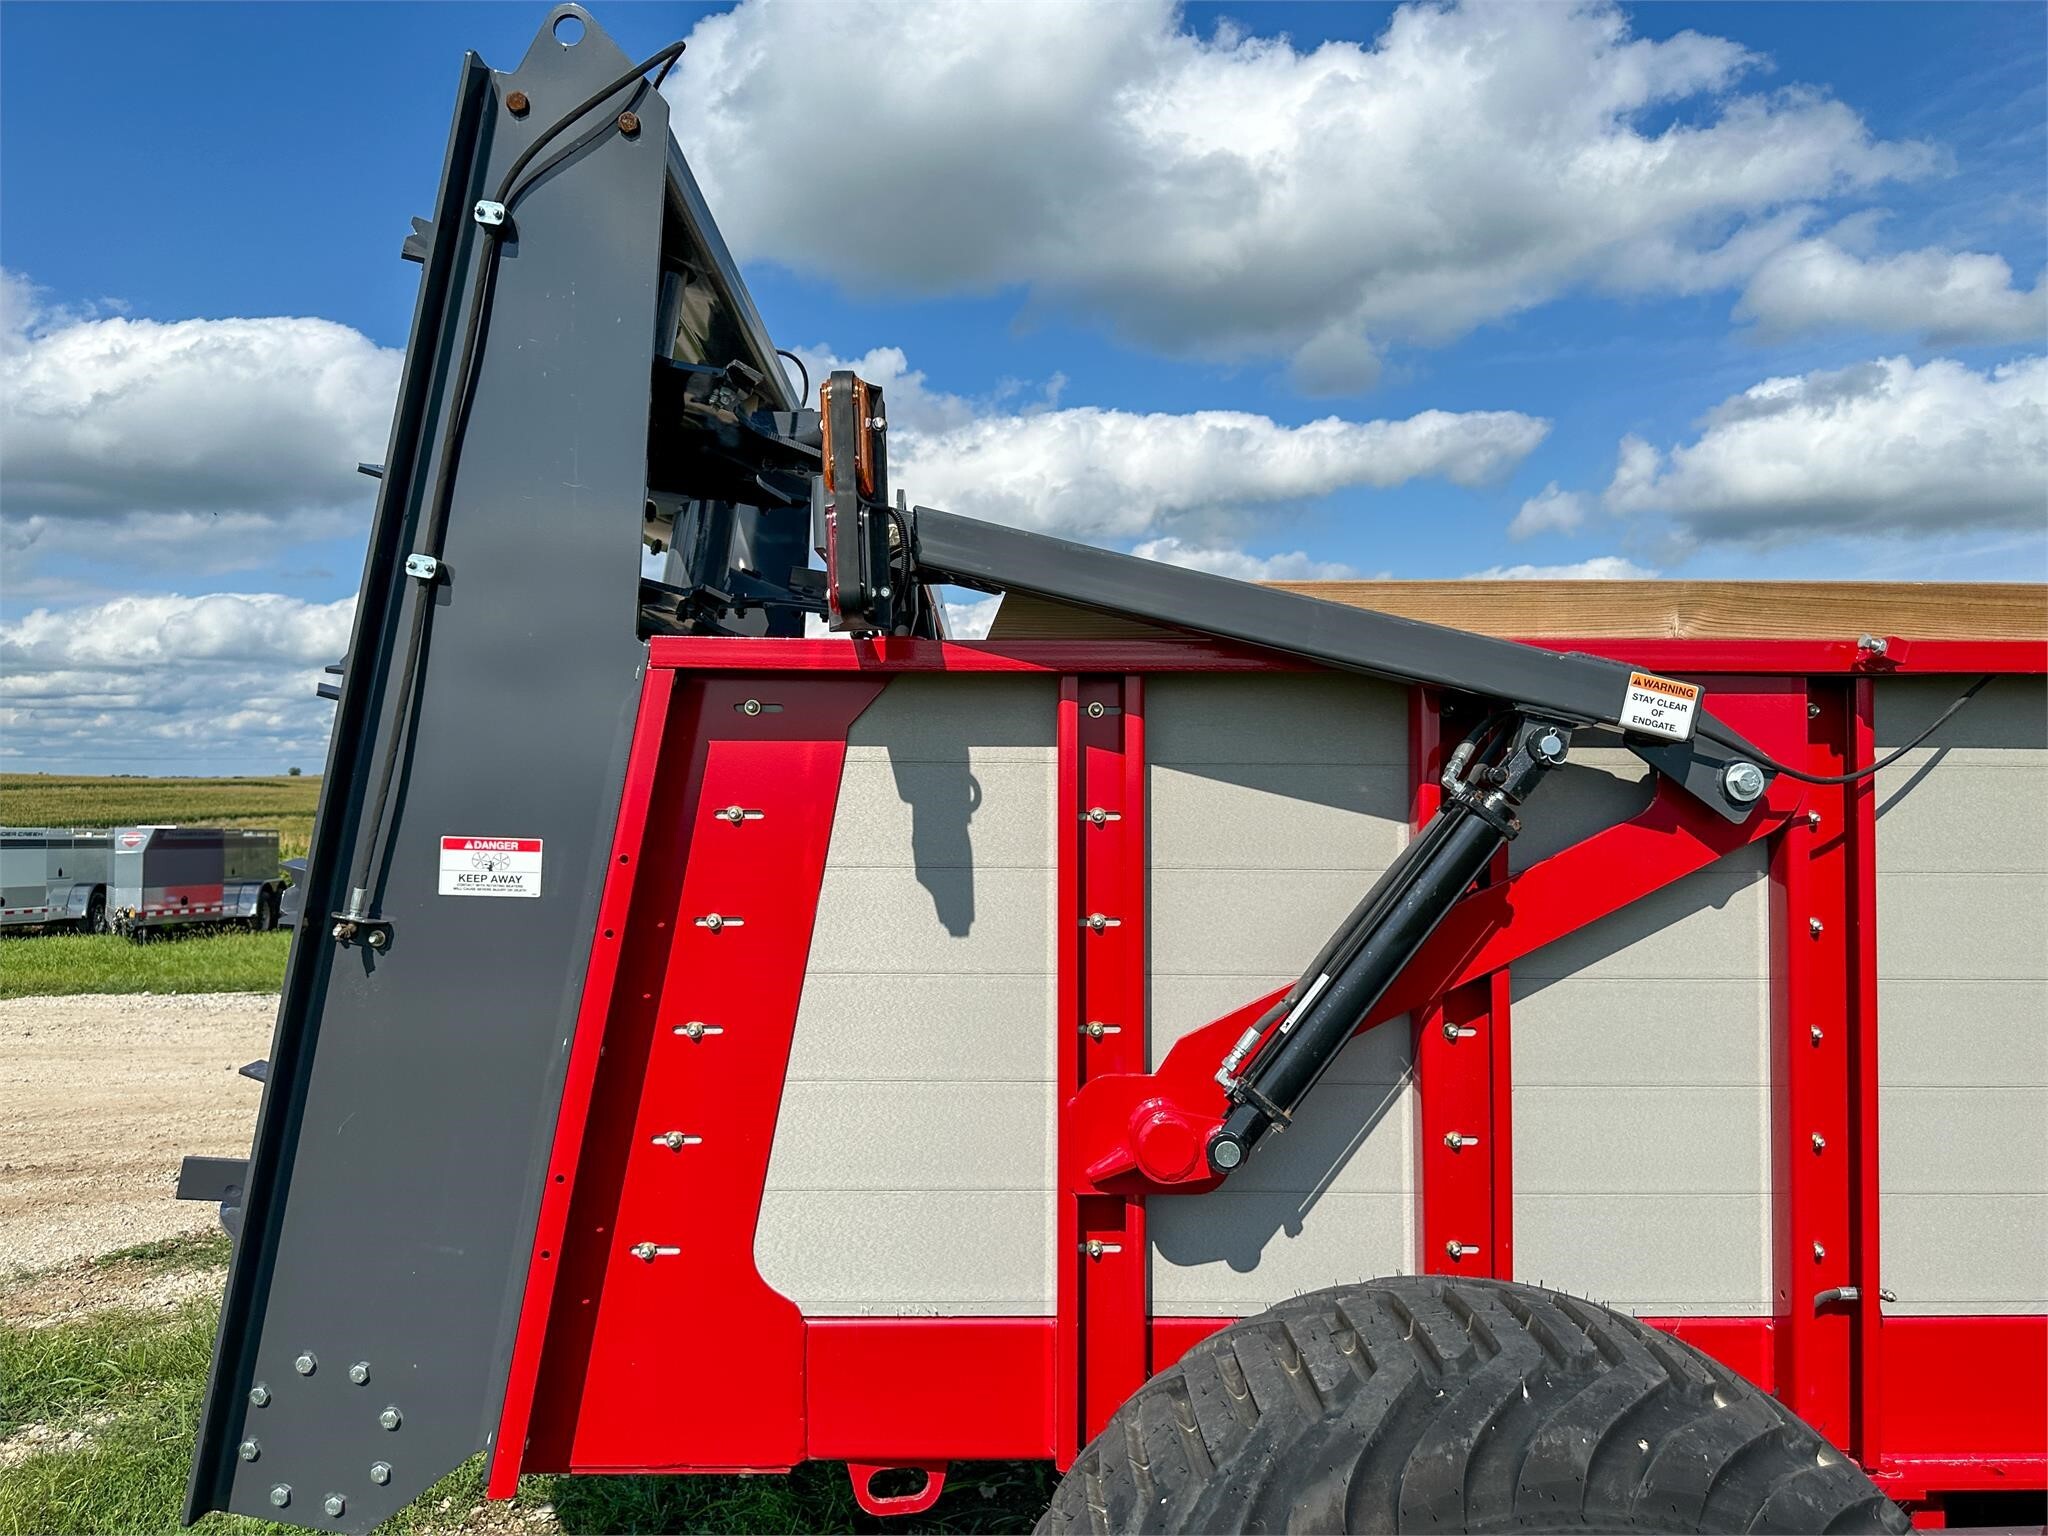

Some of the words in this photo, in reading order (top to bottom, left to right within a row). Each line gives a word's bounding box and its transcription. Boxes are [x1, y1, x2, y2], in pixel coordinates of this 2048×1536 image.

[1644, 678, 1694, 698] WARNING
[1632, 692, 1655, 705] STAY
[1657, 699, 1688, 712] CLEAR
[1651, 708, 1664, 717] OF
[1632, 716, 1677, 732] ENDGATE.
[474, 841, 519, 851] DANGER
[458, 873, 488, 883] KEEP
[490, 875, 523, 884] AWAY
